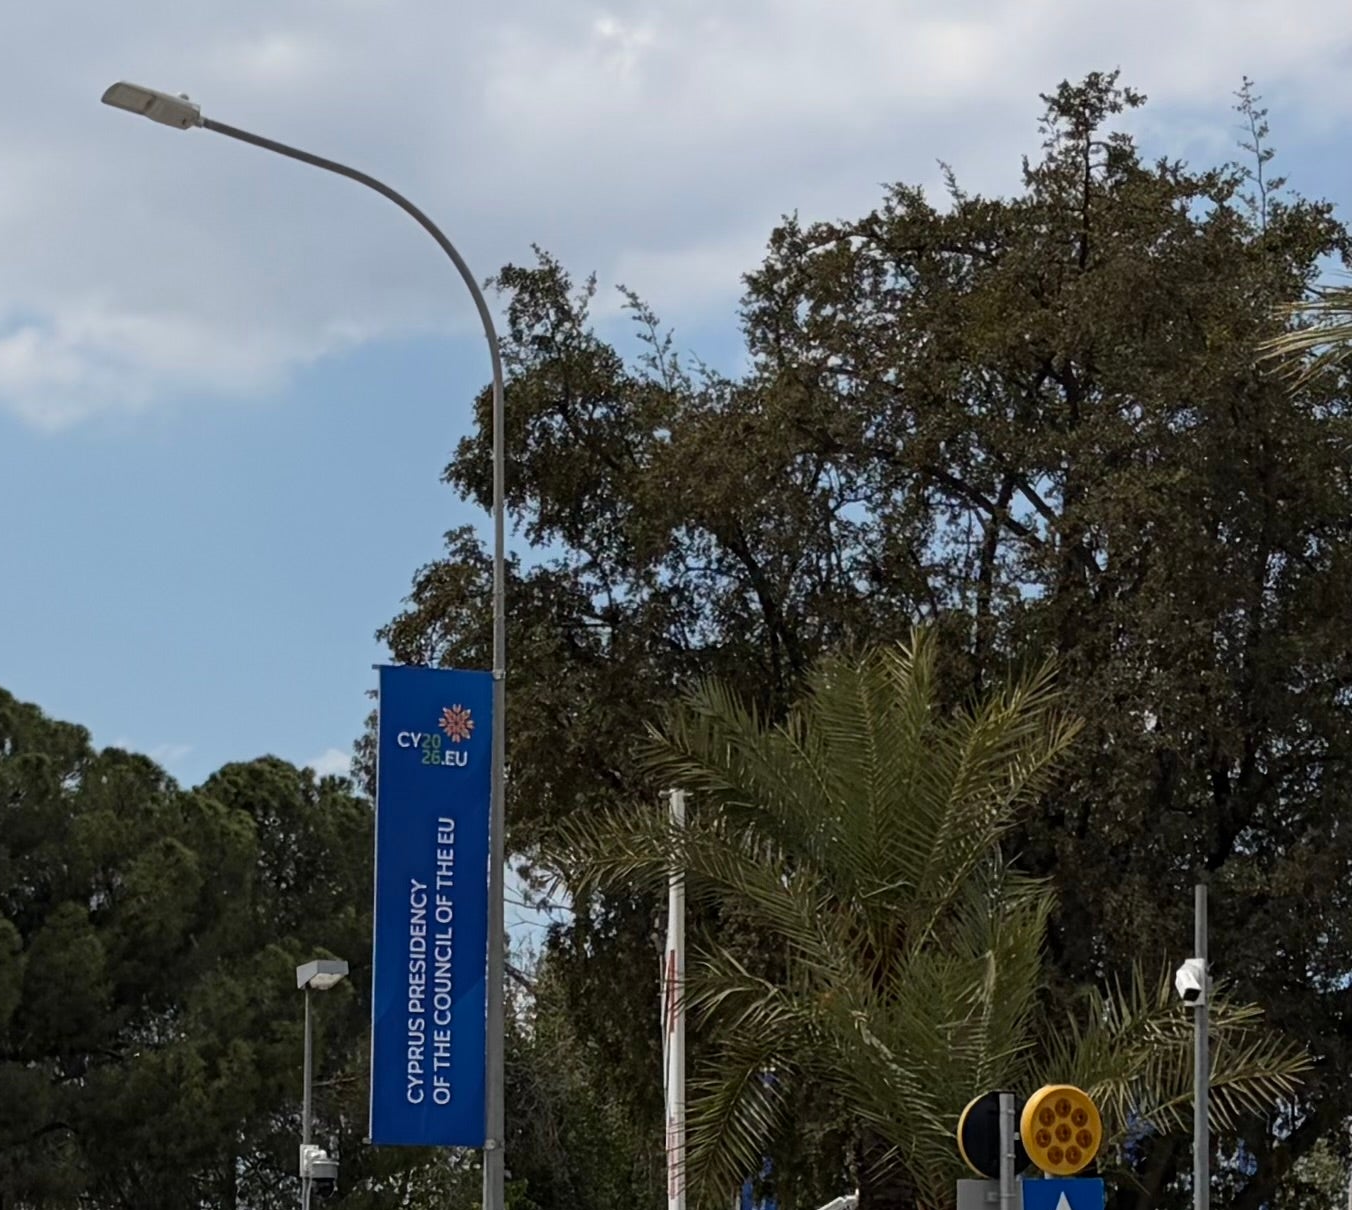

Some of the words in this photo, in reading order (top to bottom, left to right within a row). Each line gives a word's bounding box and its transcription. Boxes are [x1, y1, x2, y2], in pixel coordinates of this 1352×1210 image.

[437, 816, 456, 845] EU
[436, 848, 454, 891] THE
[435, 893, 453, 924] OF
[408, 878, 427, 1013] PRESIDENCY
[433, 926, 452, 1026] COUNCIL
[406, 1018, 425, 1104] CYPRUS
[433, 1029, 451, 1072] THE
[433, 1074, 451, 1105] OF
